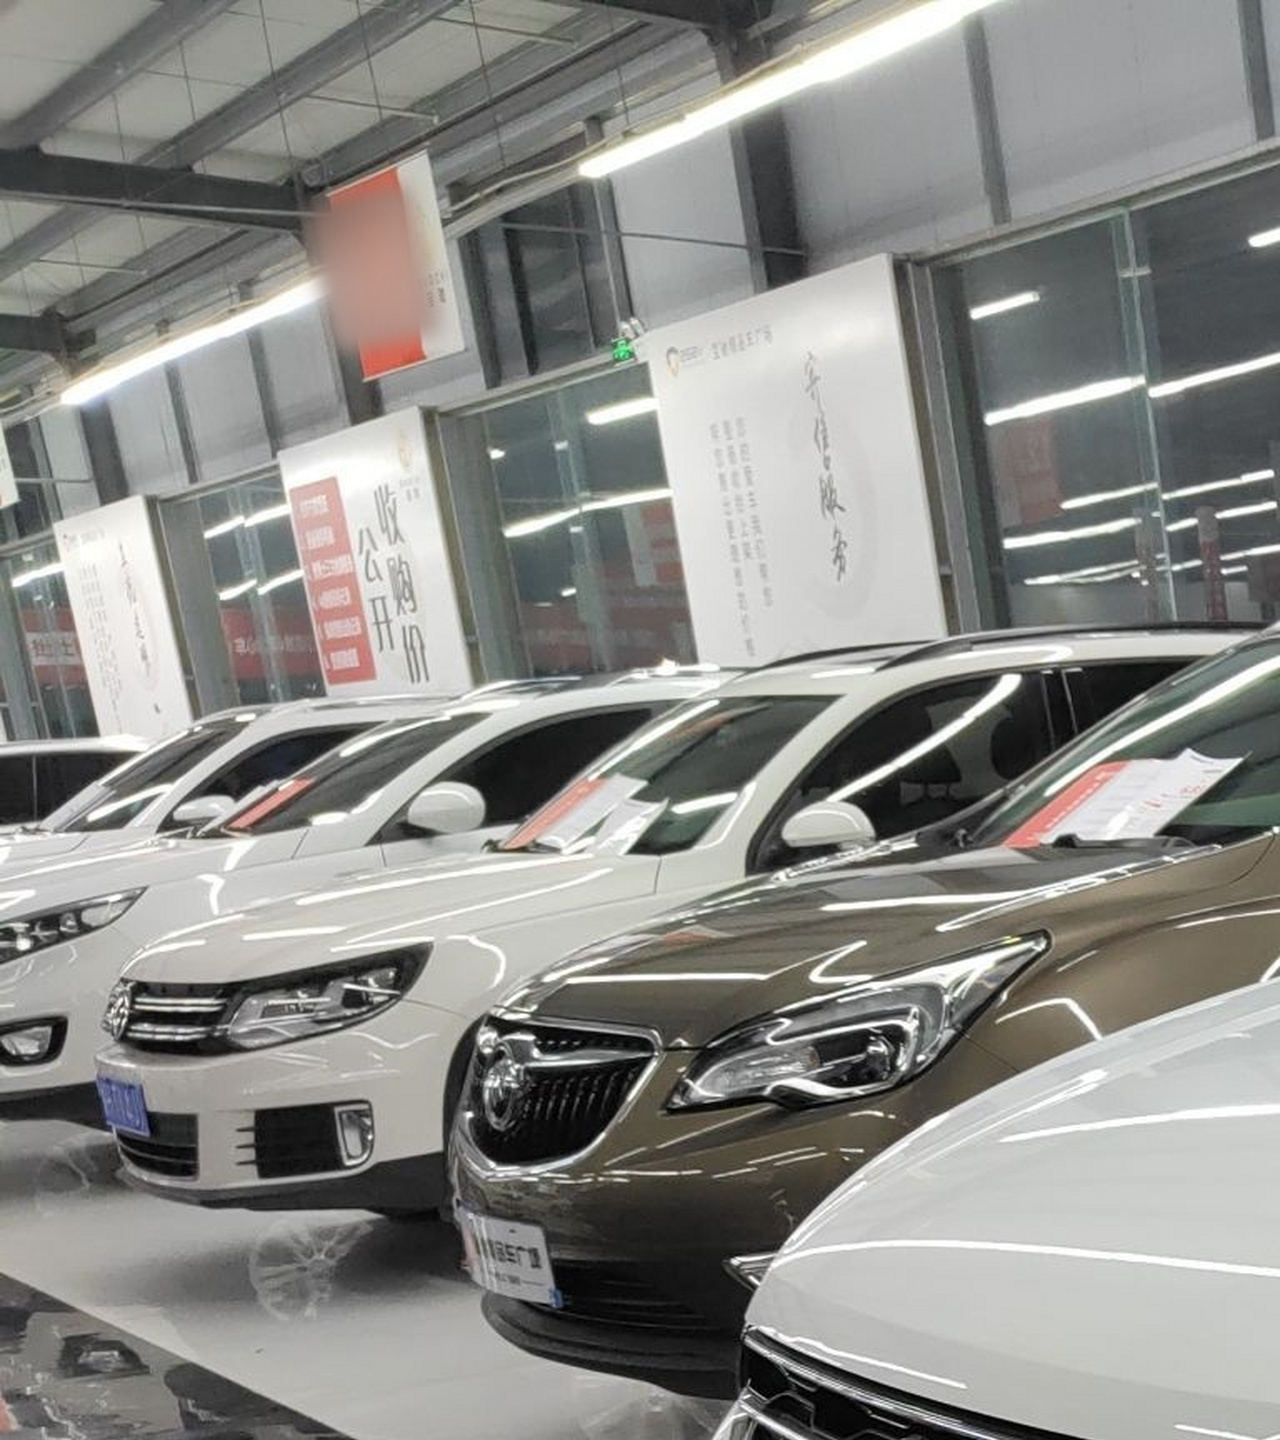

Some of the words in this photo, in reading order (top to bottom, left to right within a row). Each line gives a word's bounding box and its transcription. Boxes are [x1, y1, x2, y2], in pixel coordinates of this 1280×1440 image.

[358, 527, 395, 653] 公开
[374, 483, 430, 684] 收购价
